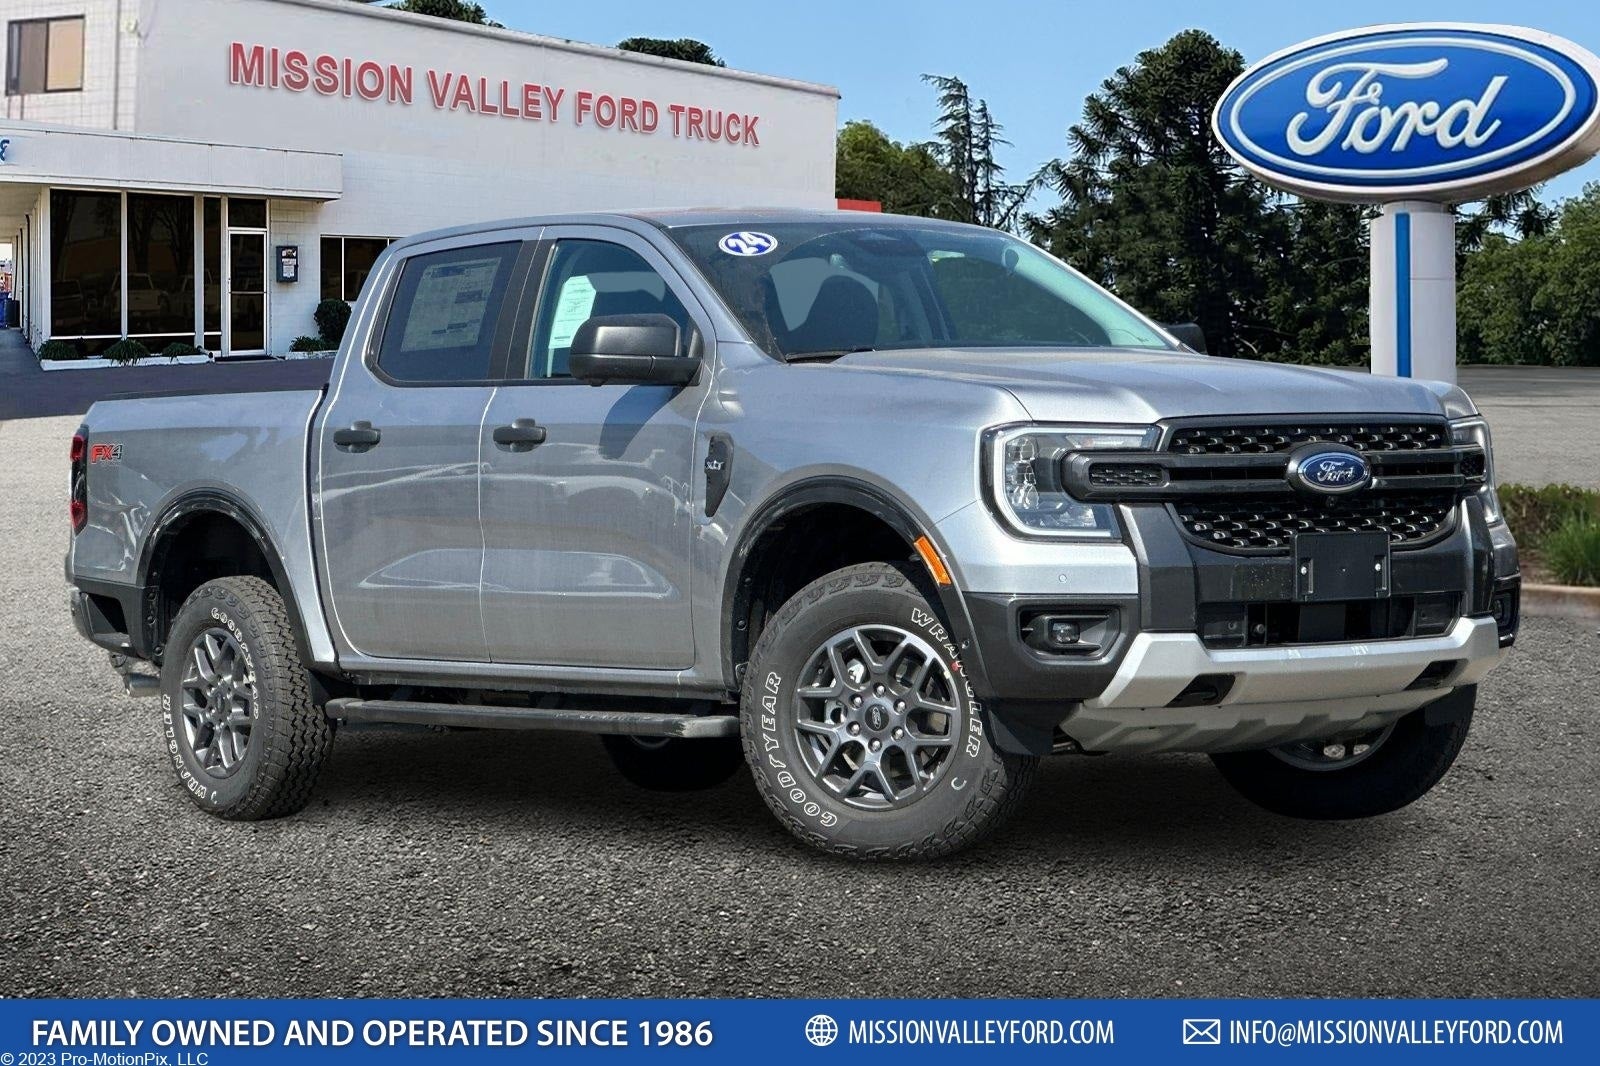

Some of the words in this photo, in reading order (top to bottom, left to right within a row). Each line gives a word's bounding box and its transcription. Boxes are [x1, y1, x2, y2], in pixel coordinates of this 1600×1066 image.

[229, 41, 413, 104] MISSION
[427, 69, 565, 122] VALLEY
[575, 90, 660, 134] FORD
[669, 103, 761, 147] TRUCK
[1286, 57, 1509, 156] Ford
[727, 231, 771, 255] 24
[91, 443, 123, 465] FX4
[1317, 460, 1355, 482] Ford
[760, 671, 838, 828] GOODYEAR
